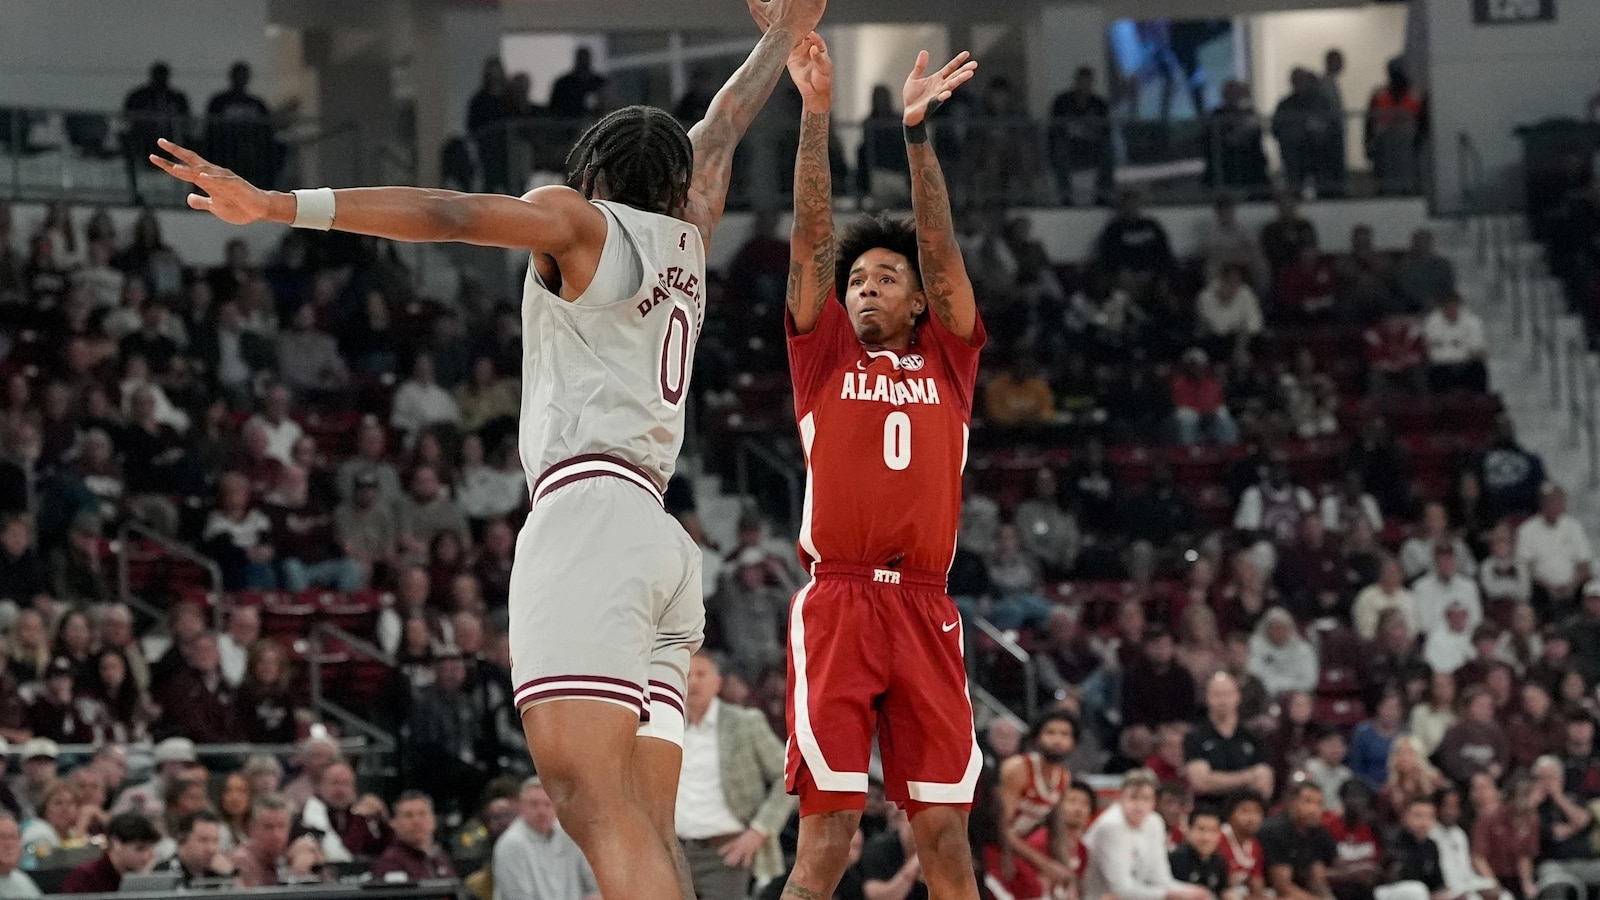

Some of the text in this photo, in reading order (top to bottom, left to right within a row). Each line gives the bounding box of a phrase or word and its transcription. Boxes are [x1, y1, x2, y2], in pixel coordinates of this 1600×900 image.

[659, 301, 691, 411] 0
[883, 411, 911, 470] 0
[873, 569, 900, 584] RTR
